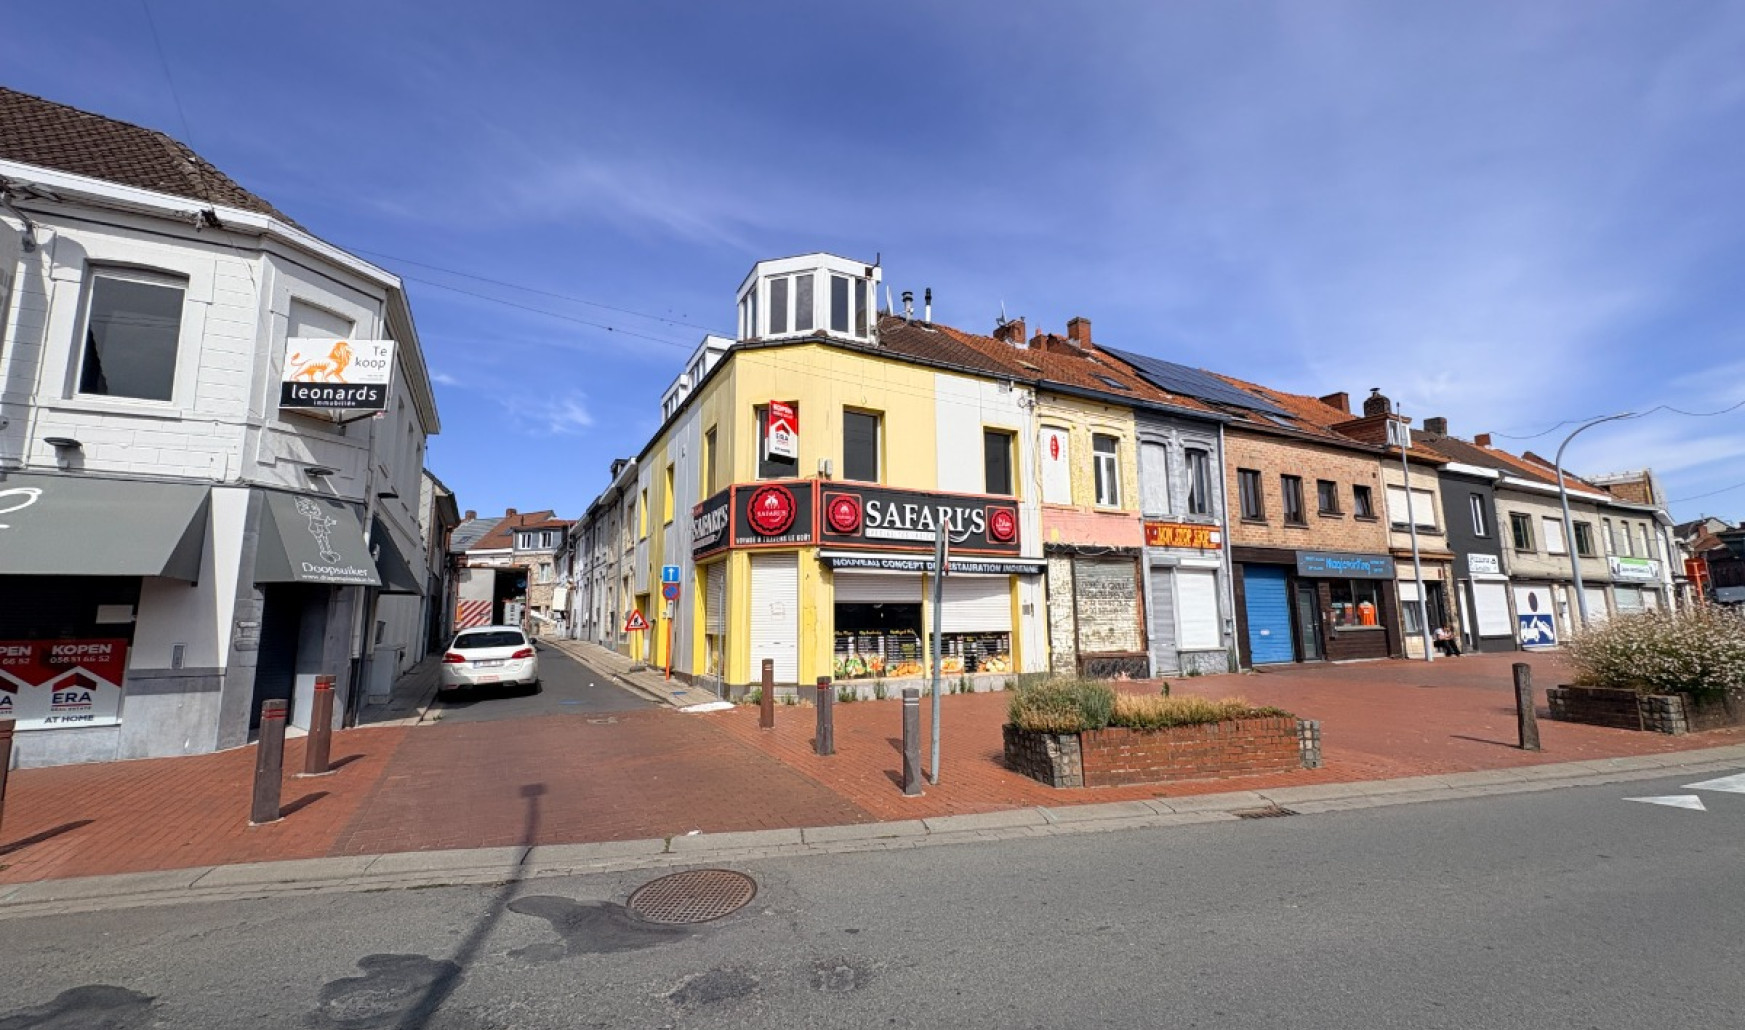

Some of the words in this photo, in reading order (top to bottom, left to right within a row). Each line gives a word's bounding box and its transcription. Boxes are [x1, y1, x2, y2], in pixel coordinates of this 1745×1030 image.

[373, 346, 387, 356] Te
[355, 357, 386, 370] koop
[292, 384, 377, 401] leonards
[866, 500, 985, 533] SAFARI'S
[302, 562, 368, 576] Doopsuiker
[882, 560, 923, 569] CONCEPT
[948, 562, 1001, 572] ESTAURATION
[52, 644, 112, 655] KOPEN
[52, 691, 92, 704] ERA
